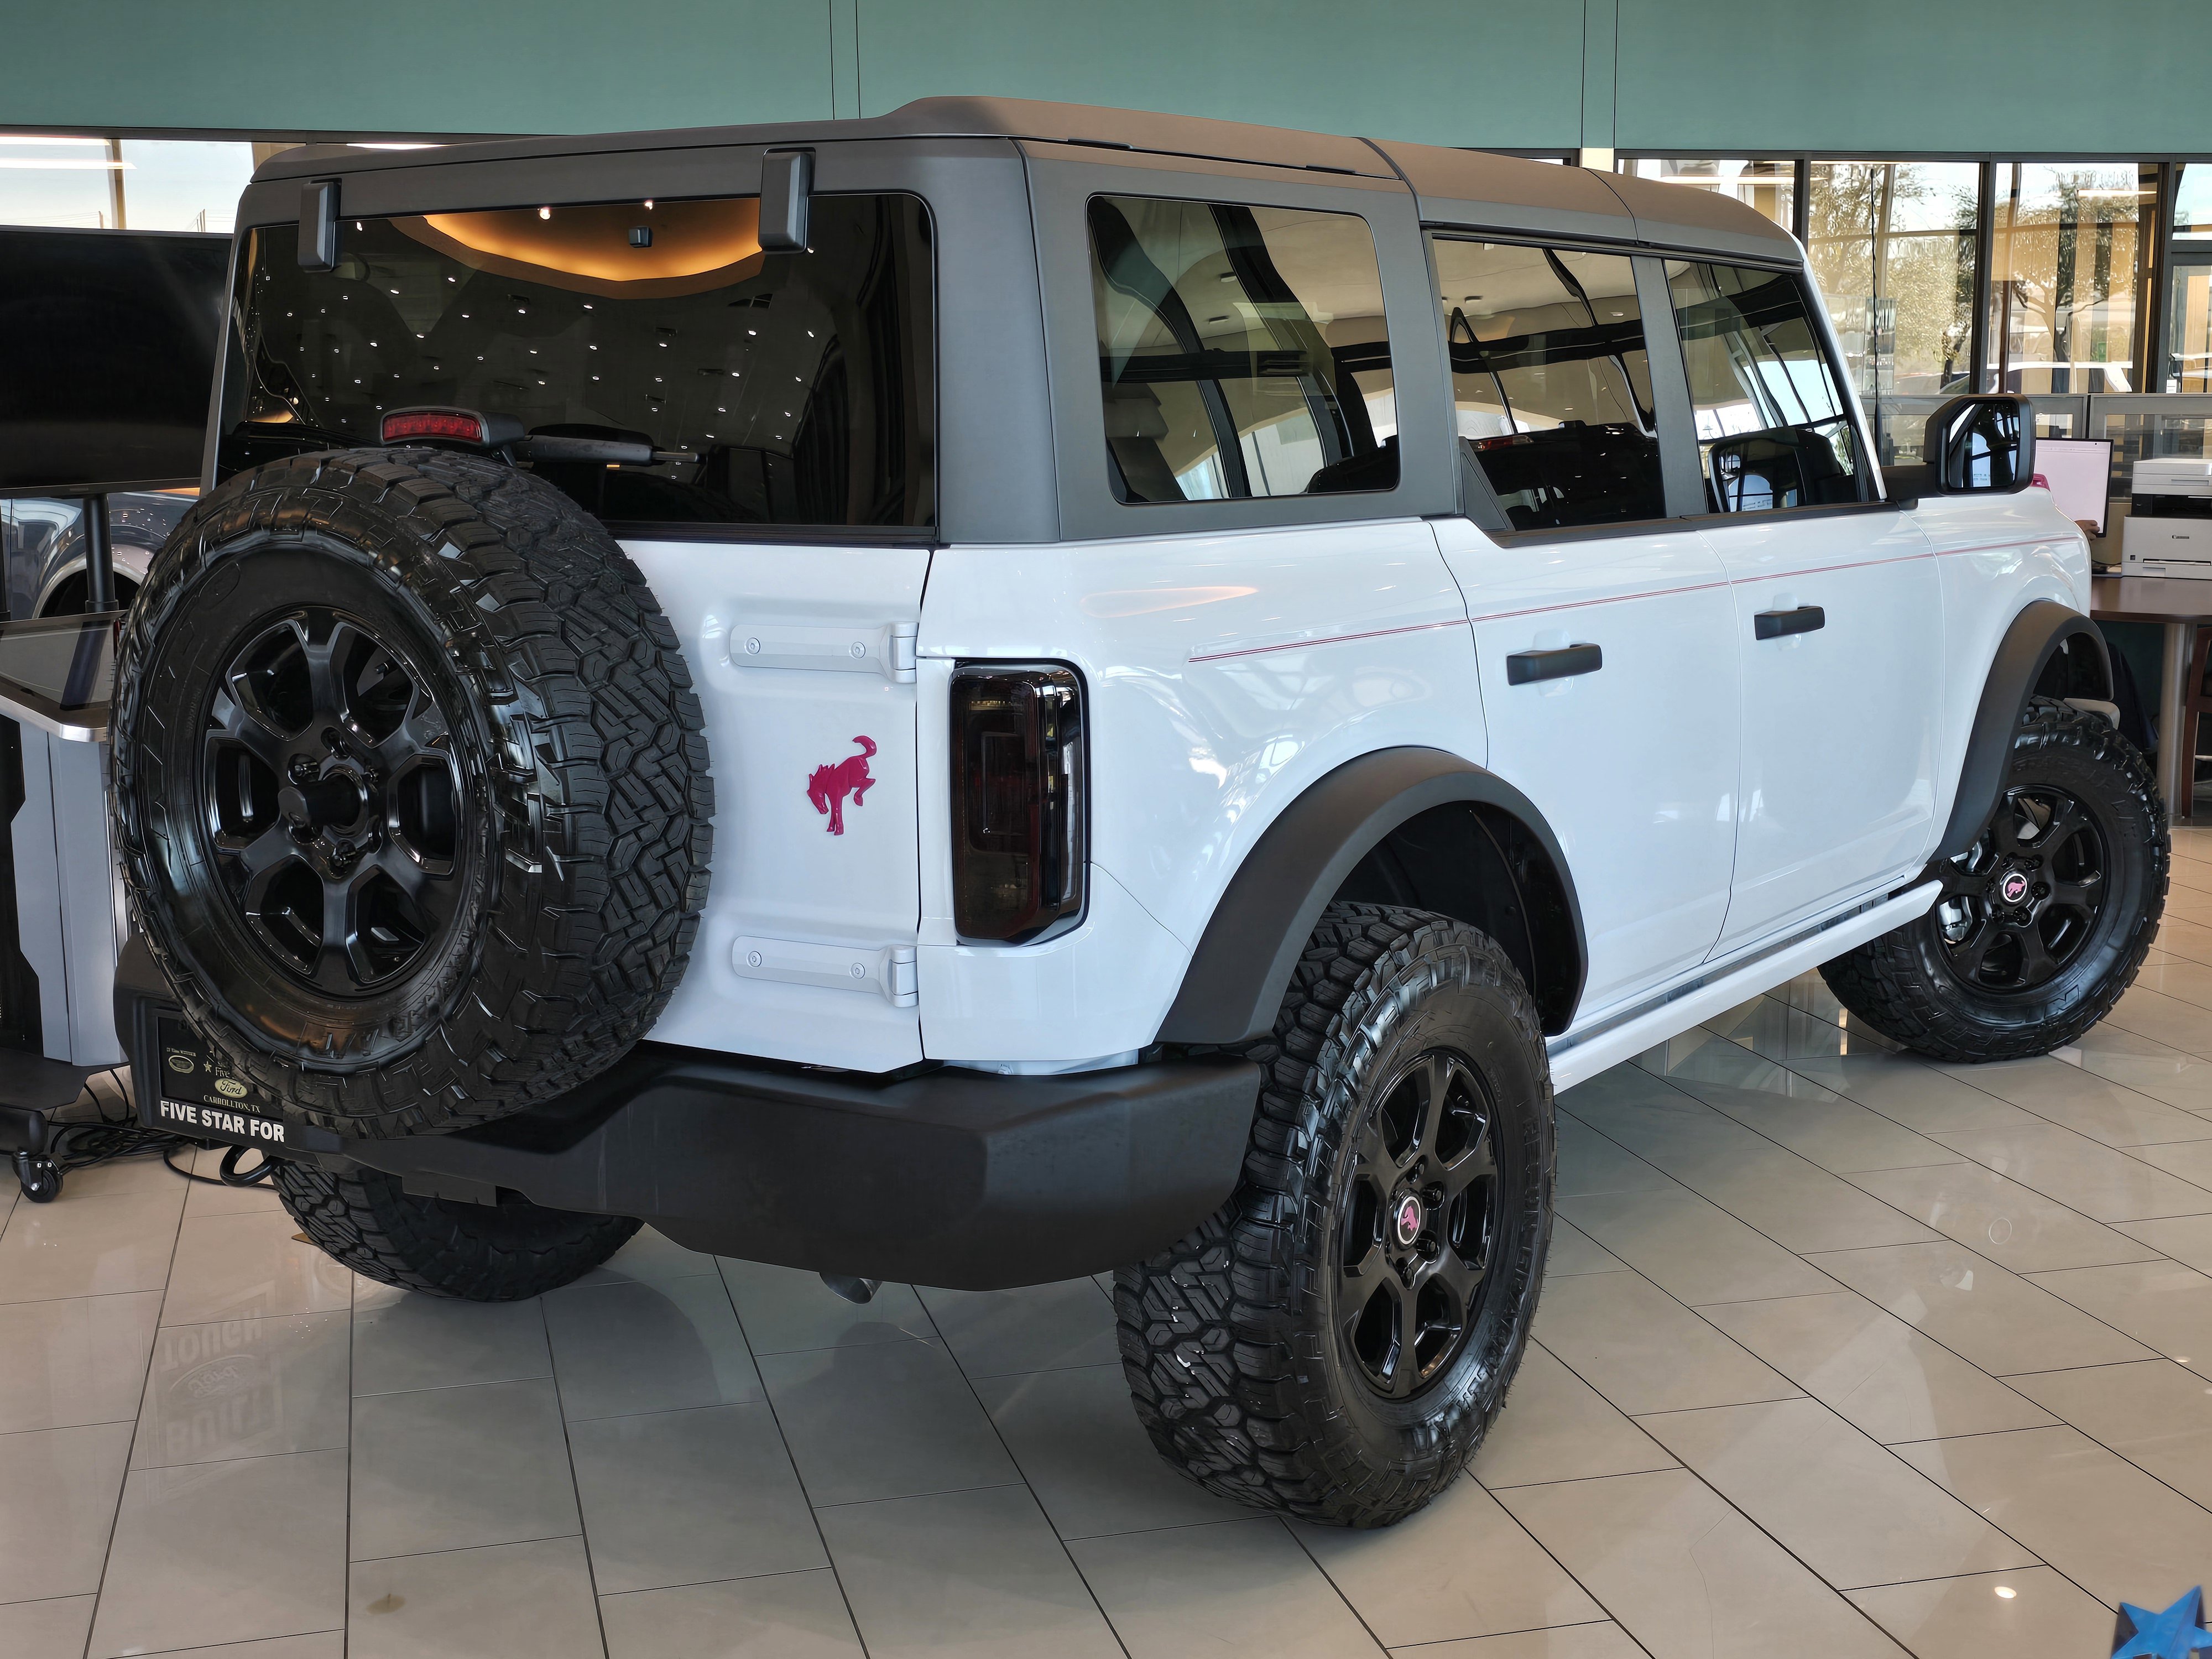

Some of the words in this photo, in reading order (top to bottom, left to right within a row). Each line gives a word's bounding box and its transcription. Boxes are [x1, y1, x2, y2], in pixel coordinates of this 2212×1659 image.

[219, 1079, 243, 1095] Ford
[160, 1100, 197, 1124] FIVE
[201, 1109, 246, 1134] STAR
